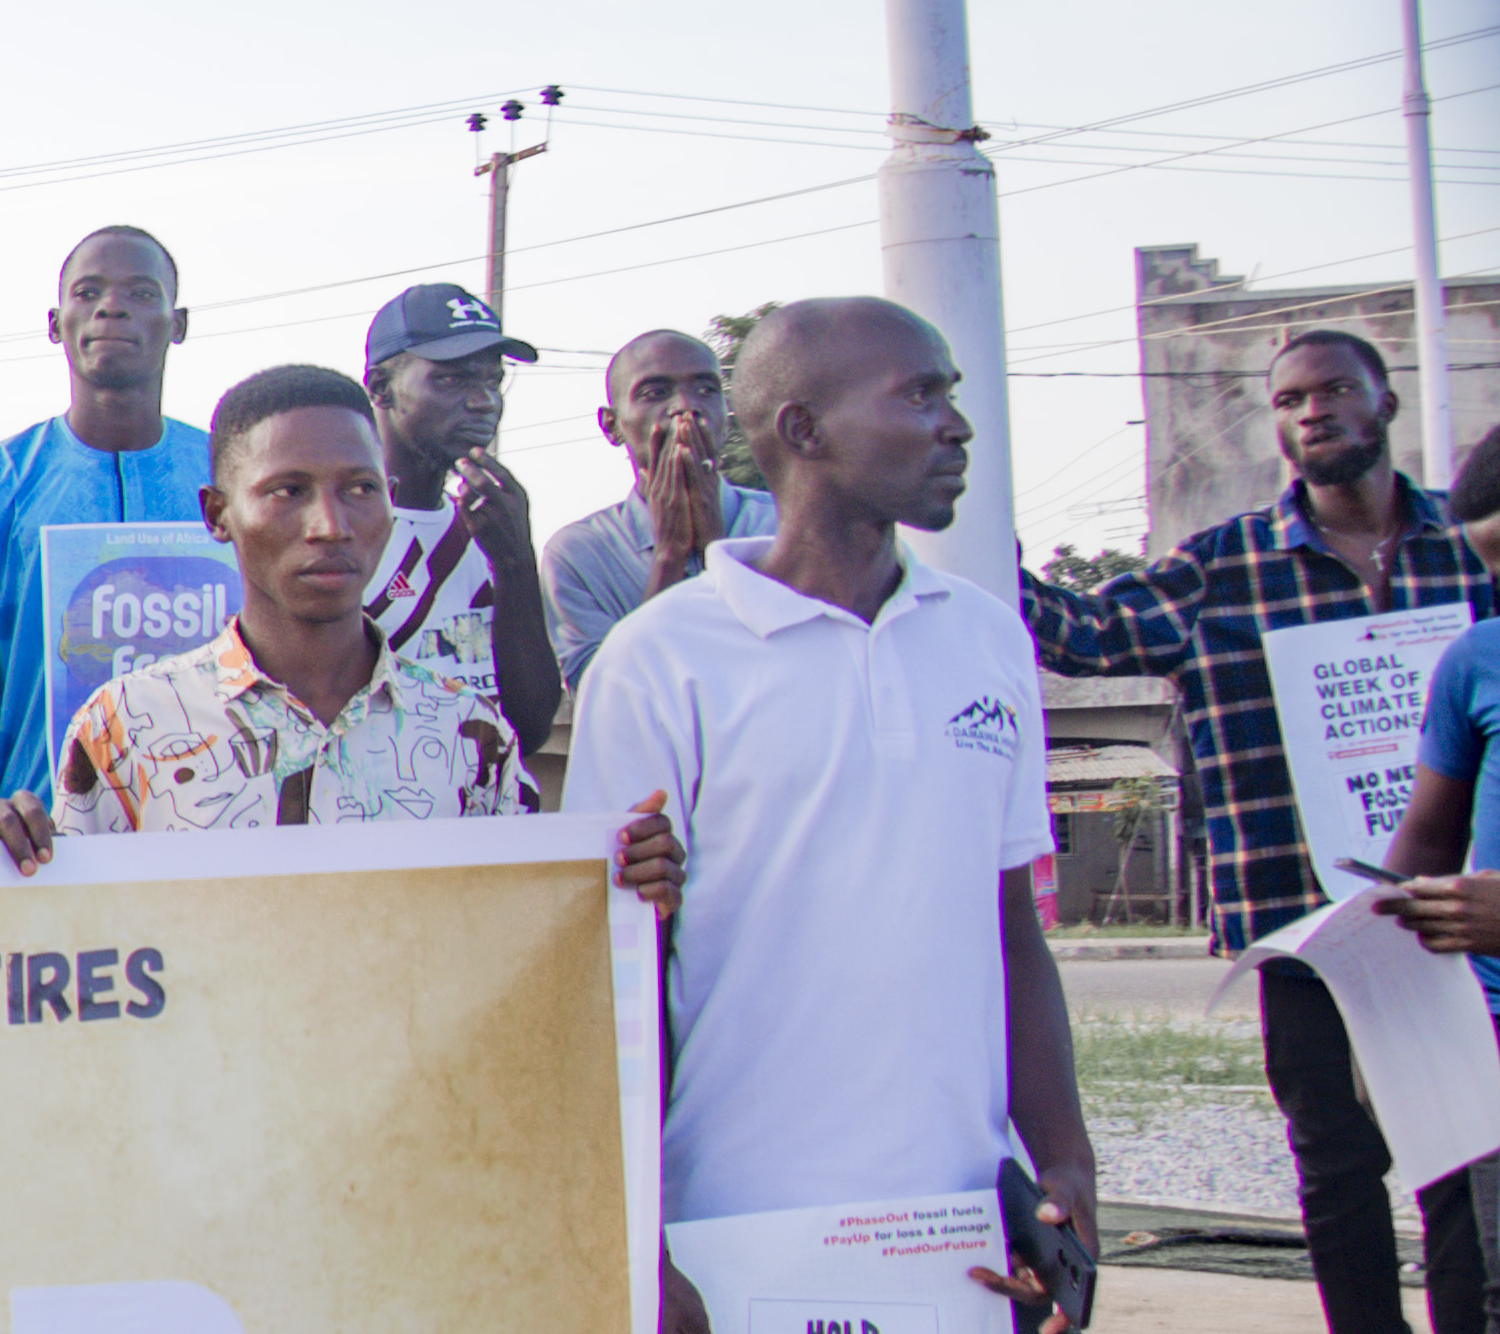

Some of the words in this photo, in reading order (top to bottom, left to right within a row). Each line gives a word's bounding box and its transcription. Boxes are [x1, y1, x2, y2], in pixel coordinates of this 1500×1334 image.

[106, 533, 135, 545] Land
[138, 533, 159, 544] Use
[163, 532, 175, 543] of
[1313, 654, 1404, 680] GLOBAL
[1315, 678, 1382, 700] WEEK
[1390, 671, 1421, 689] OF
[1320, 691, 1422, 720] CLIMATE
[1325, 711, 1422, 740] ACTIONS
[1346, 772, 1380, 794] NO
[1385, 764, 1415, 784] NE
[1361, 785, 1411, 812] FOSS
[840, 1212, 909, 1227] #PhaseOut
[913, 1208, 947, 1220] fossil
[952, 1205, 984, 1217] fuels
[824, 1233, 871, 1246] #PayUp
[875, 1231, 892, 1241] for
[897, 1229, 922, 1239] loss
[941, 1222, 991, 1236] damage
[882, 1239, 987, 1257] #FundOurFuture
